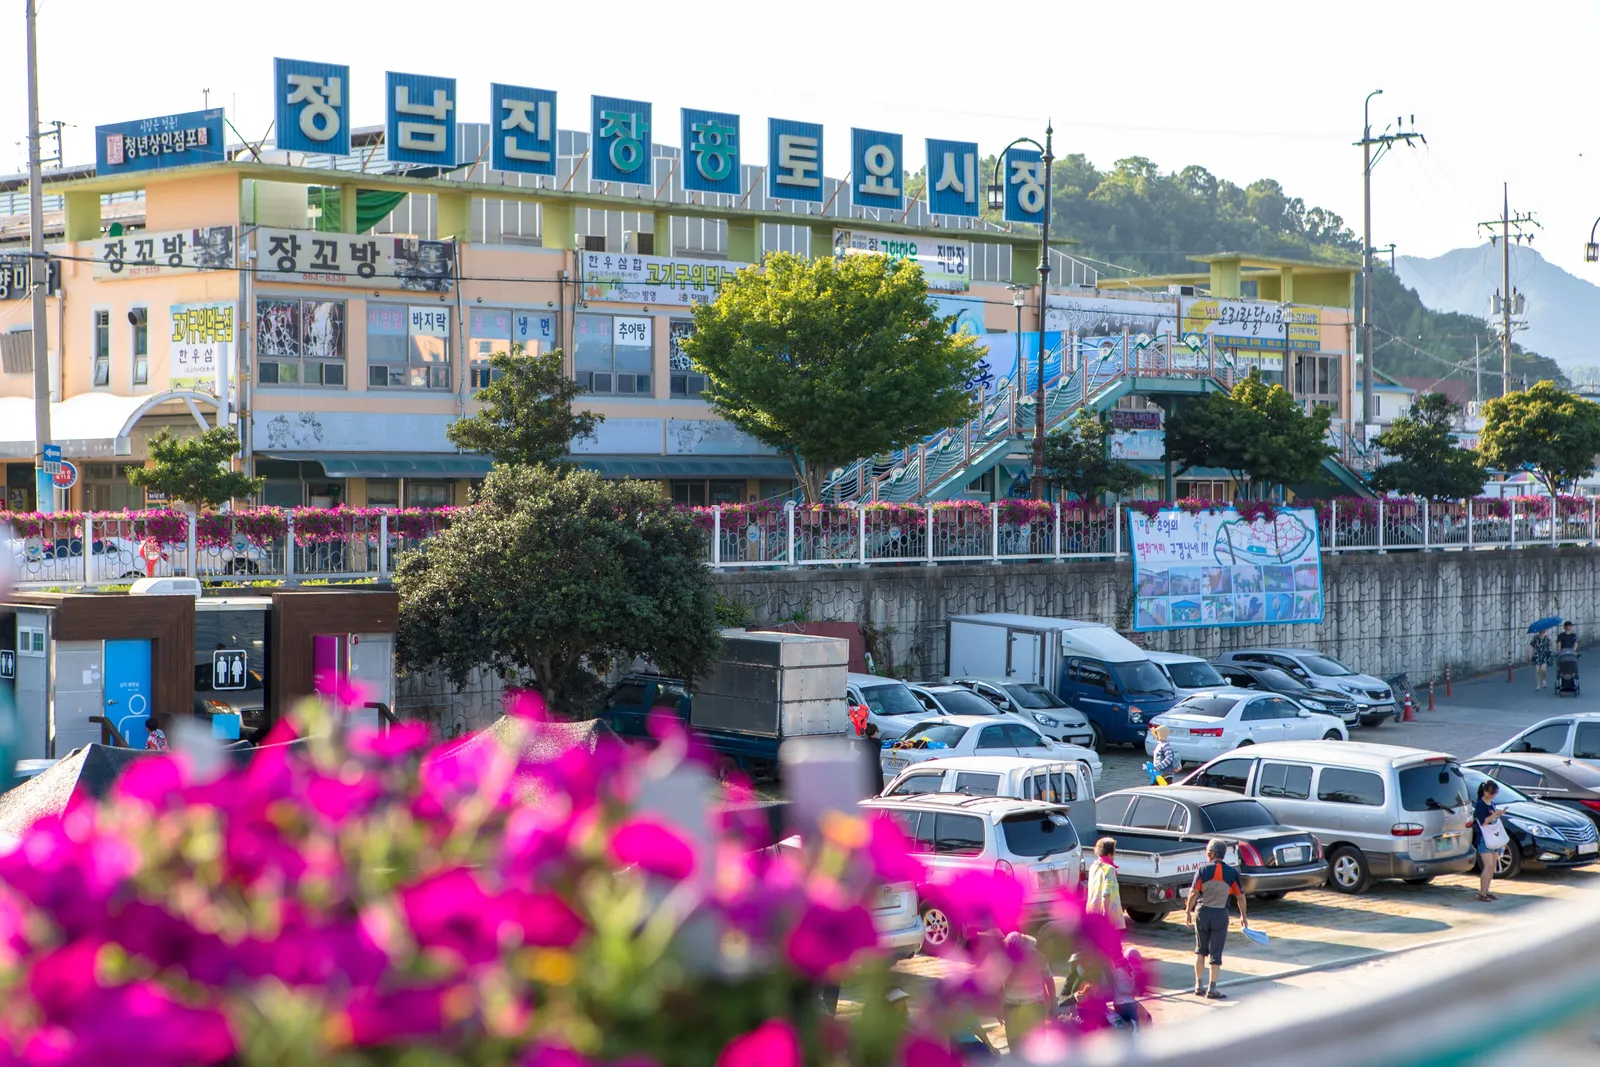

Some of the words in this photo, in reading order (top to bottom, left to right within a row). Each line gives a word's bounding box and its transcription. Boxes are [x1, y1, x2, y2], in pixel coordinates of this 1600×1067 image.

[103, 233, 187, 274] 장꼬방
[268, 234, 381, 279] 장꼬방
[302, 272, 347, 283] 863-8338
[646, 263, 746, 294] 고기구워먹는
[172, 306, 234, 345] 고기구워먹는집
[412, 312, 447, 331] 바지락
[619, 322, 646, 340] 추어탕
[179, 348, 213, 363] 한우삼
[1156, 519, 1179, 538] 추억의
[1137, 541, 1166, 561] 벽화거리
[1176, 864, 1191, 873] KIA
